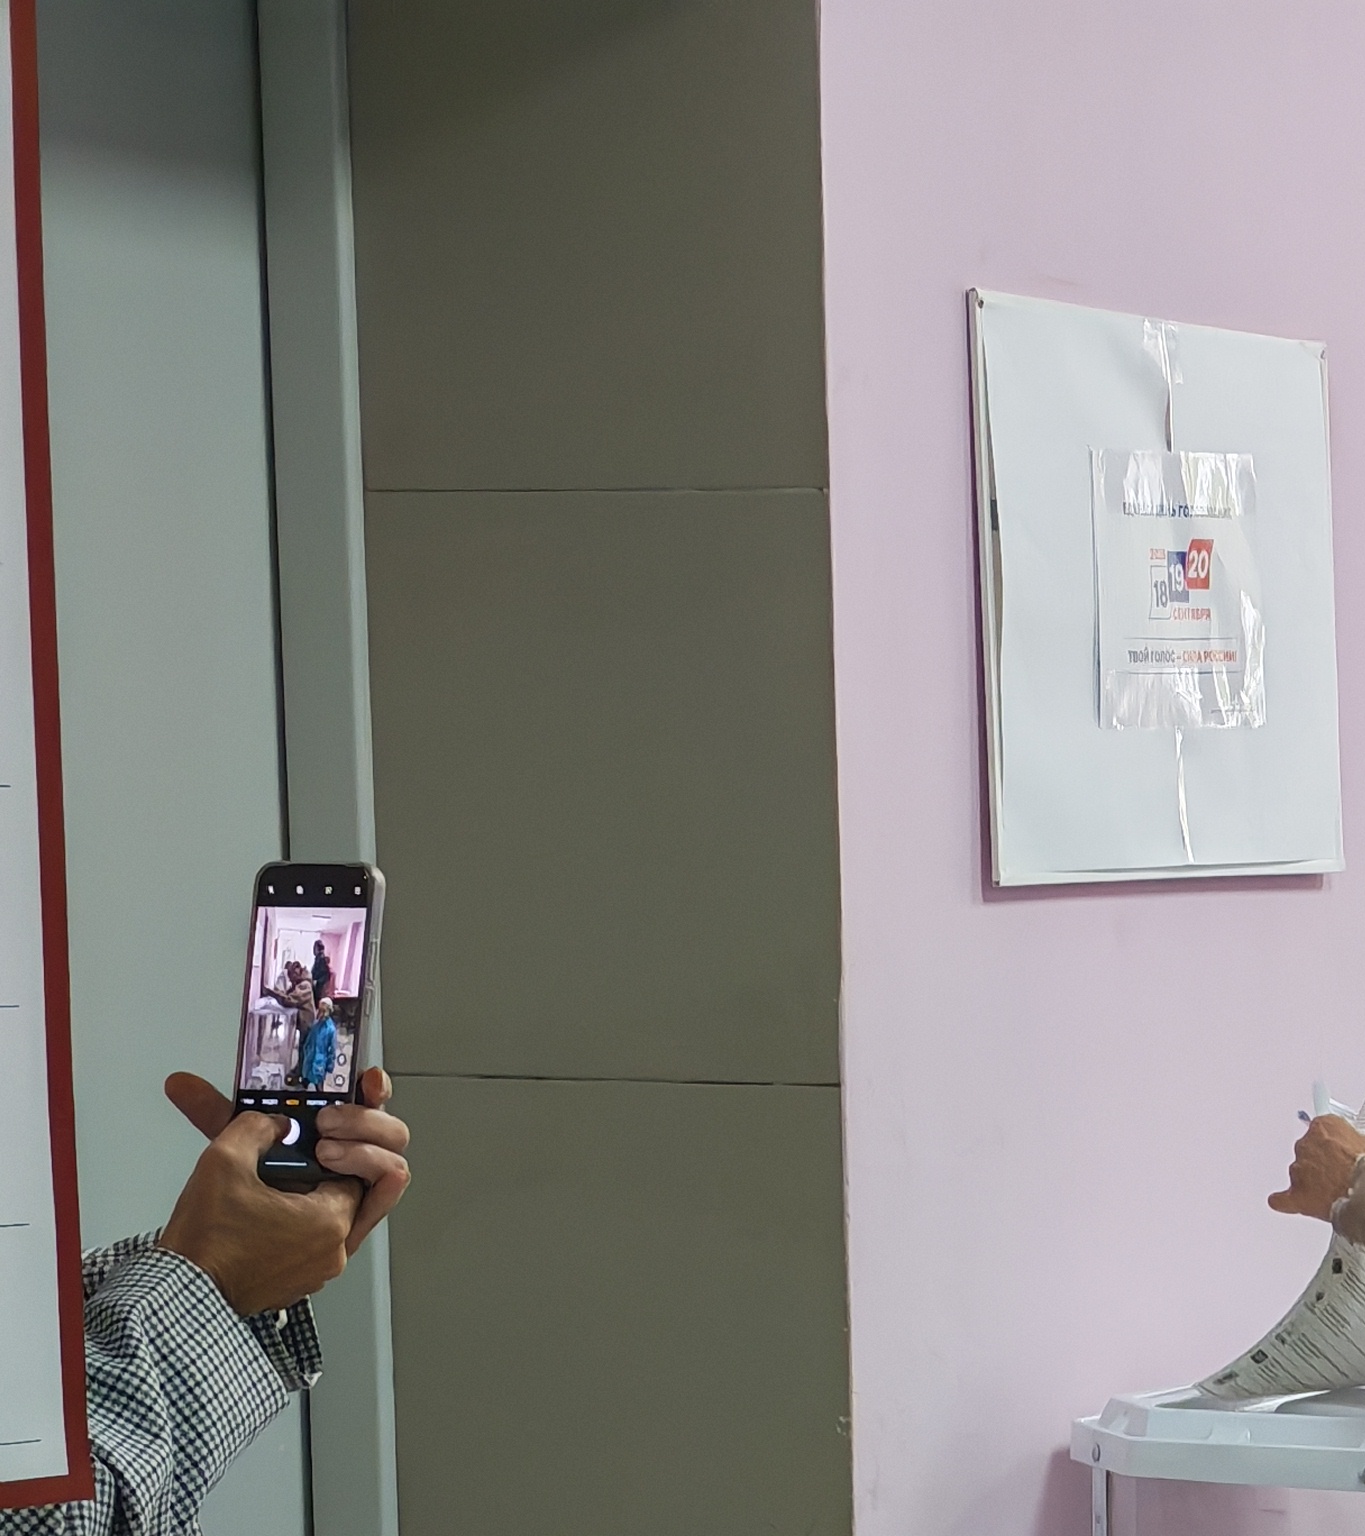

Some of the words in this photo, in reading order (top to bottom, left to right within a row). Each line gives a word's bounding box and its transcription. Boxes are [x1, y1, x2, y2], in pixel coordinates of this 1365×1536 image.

[1169, 563, 1185, 593] 19
[1188, 550, 1209, 578] 20
[1153, 580, 1168, 608] 18
[1128, 647, 1149, 663] ТВОЙ
[1151, 650, 1175, 663] ГОЛОС
